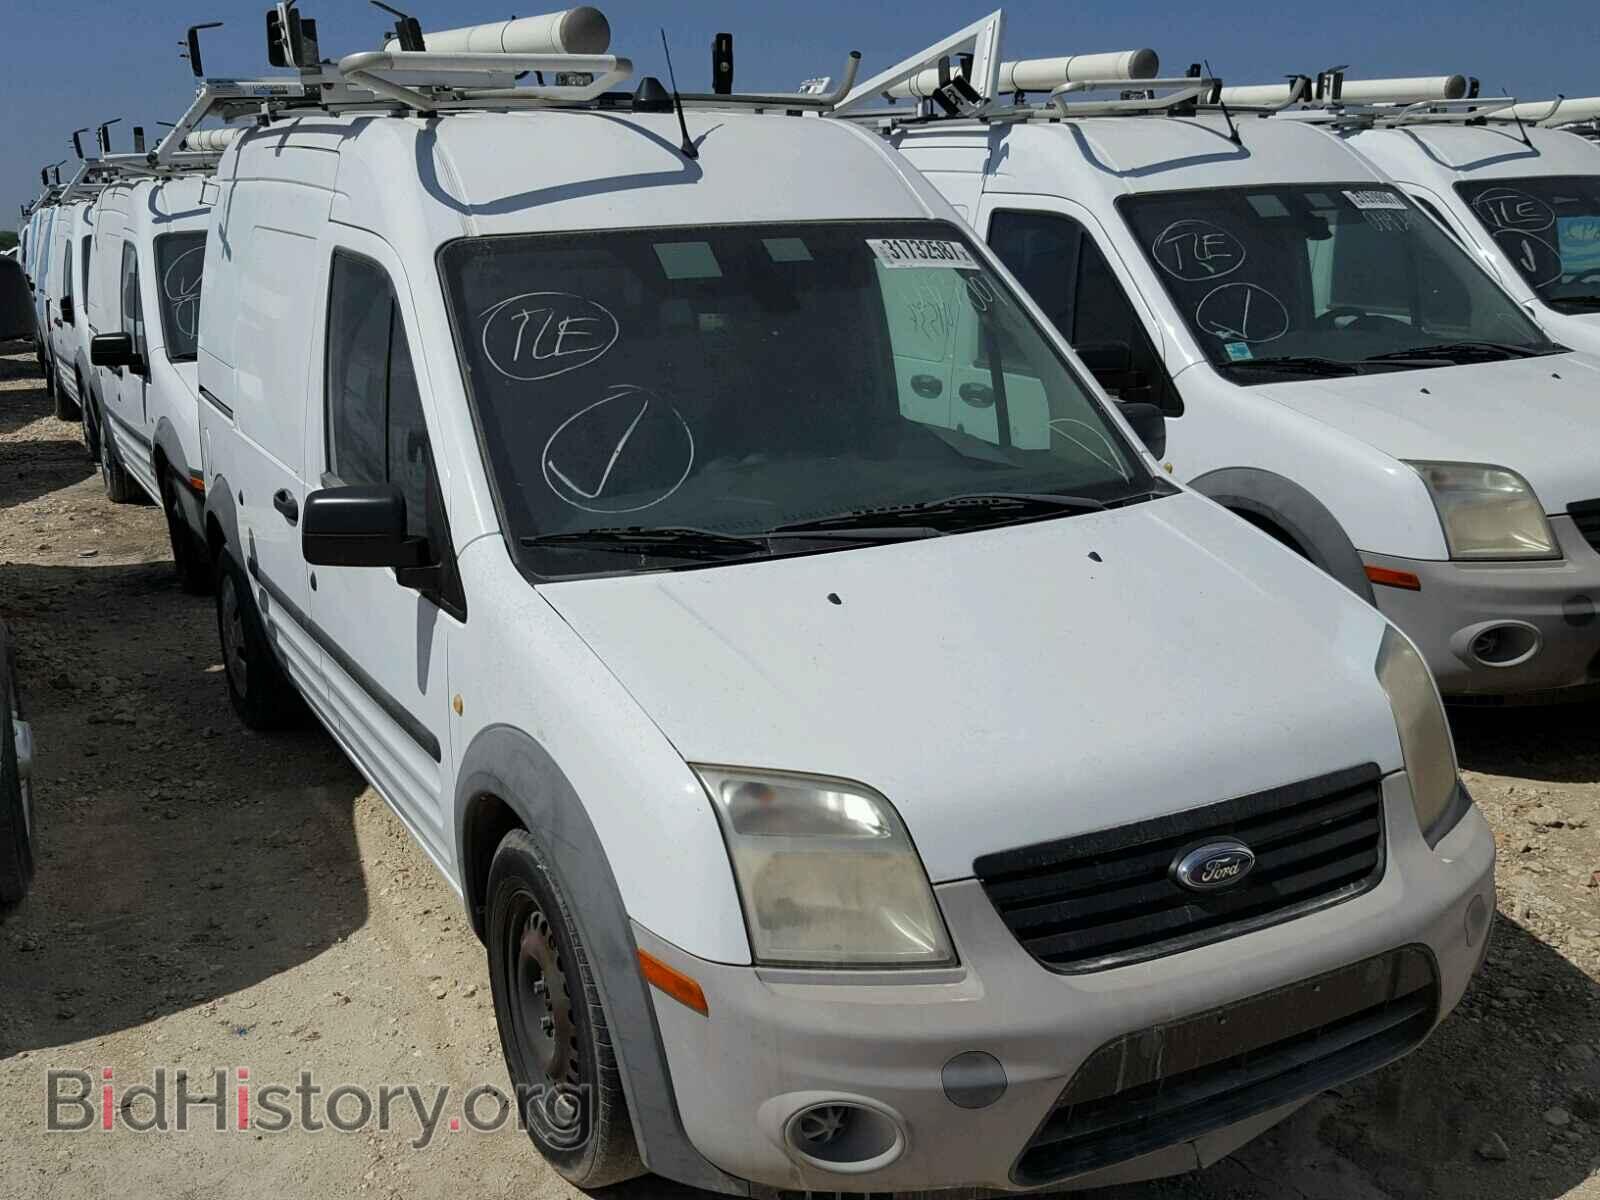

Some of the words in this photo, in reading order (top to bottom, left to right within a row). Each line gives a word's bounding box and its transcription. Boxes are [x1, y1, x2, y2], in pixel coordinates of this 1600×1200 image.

[881, 239, 961, 261] 31732587
[1163, 232, 1233, 271] TLE
[511, 307, 604, 362] TLE
[1201, 856, 1241, 882] Ford
